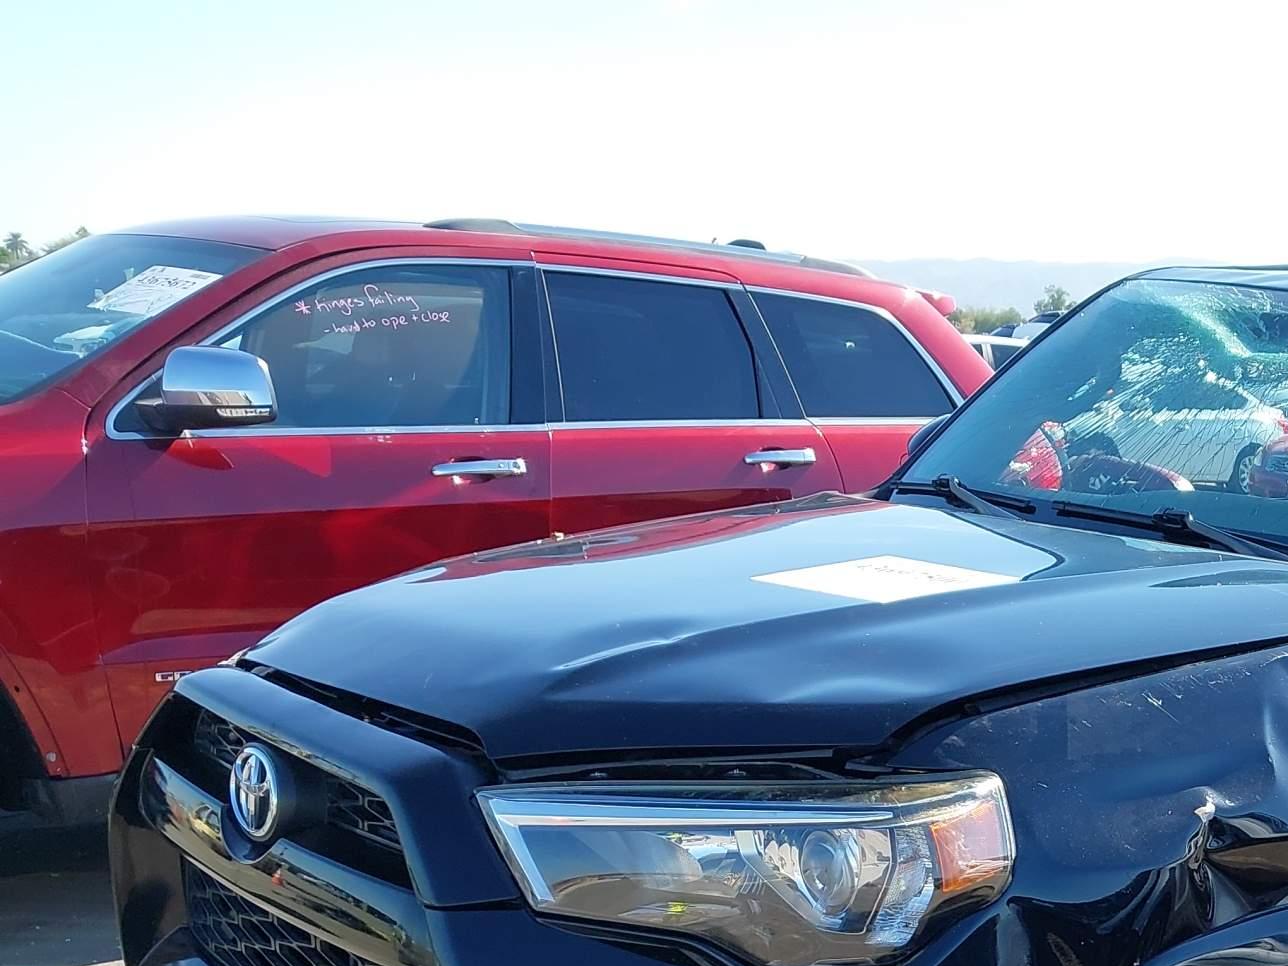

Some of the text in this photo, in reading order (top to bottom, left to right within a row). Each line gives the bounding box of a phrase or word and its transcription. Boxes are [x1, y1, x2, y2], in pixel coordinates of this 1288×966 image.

[315, 284, 419, 315] hinges failing
[363, 318, 376, 328] to
[381, 316, 408, 329] ope
